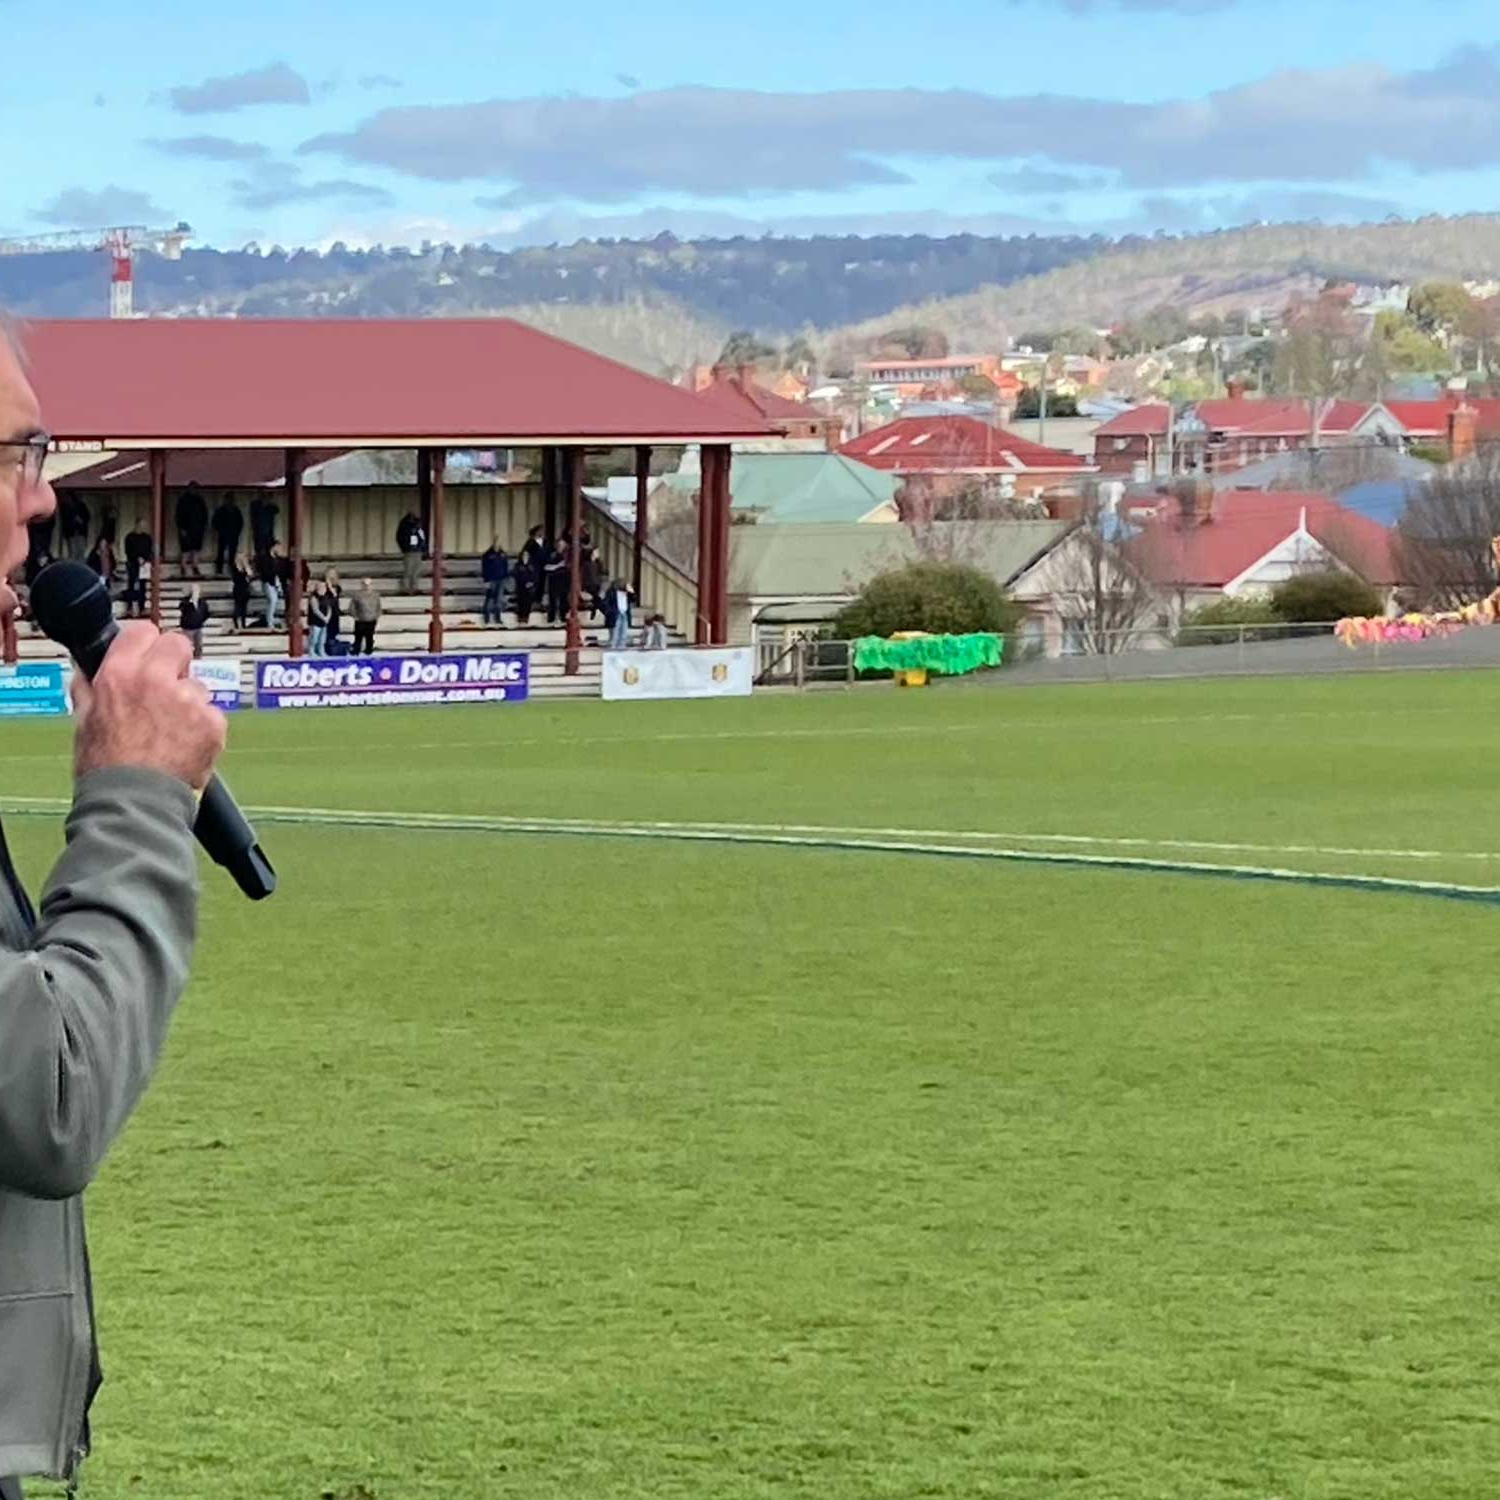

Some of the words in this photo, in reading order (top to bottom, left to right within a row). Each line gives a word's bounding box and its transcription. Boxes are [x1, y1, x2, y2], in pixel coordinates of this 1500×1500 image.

[262, 661, 373, 688] Roberts
[400, 659, 459, 684] Don
[464, 657, 522, 682] Mac
